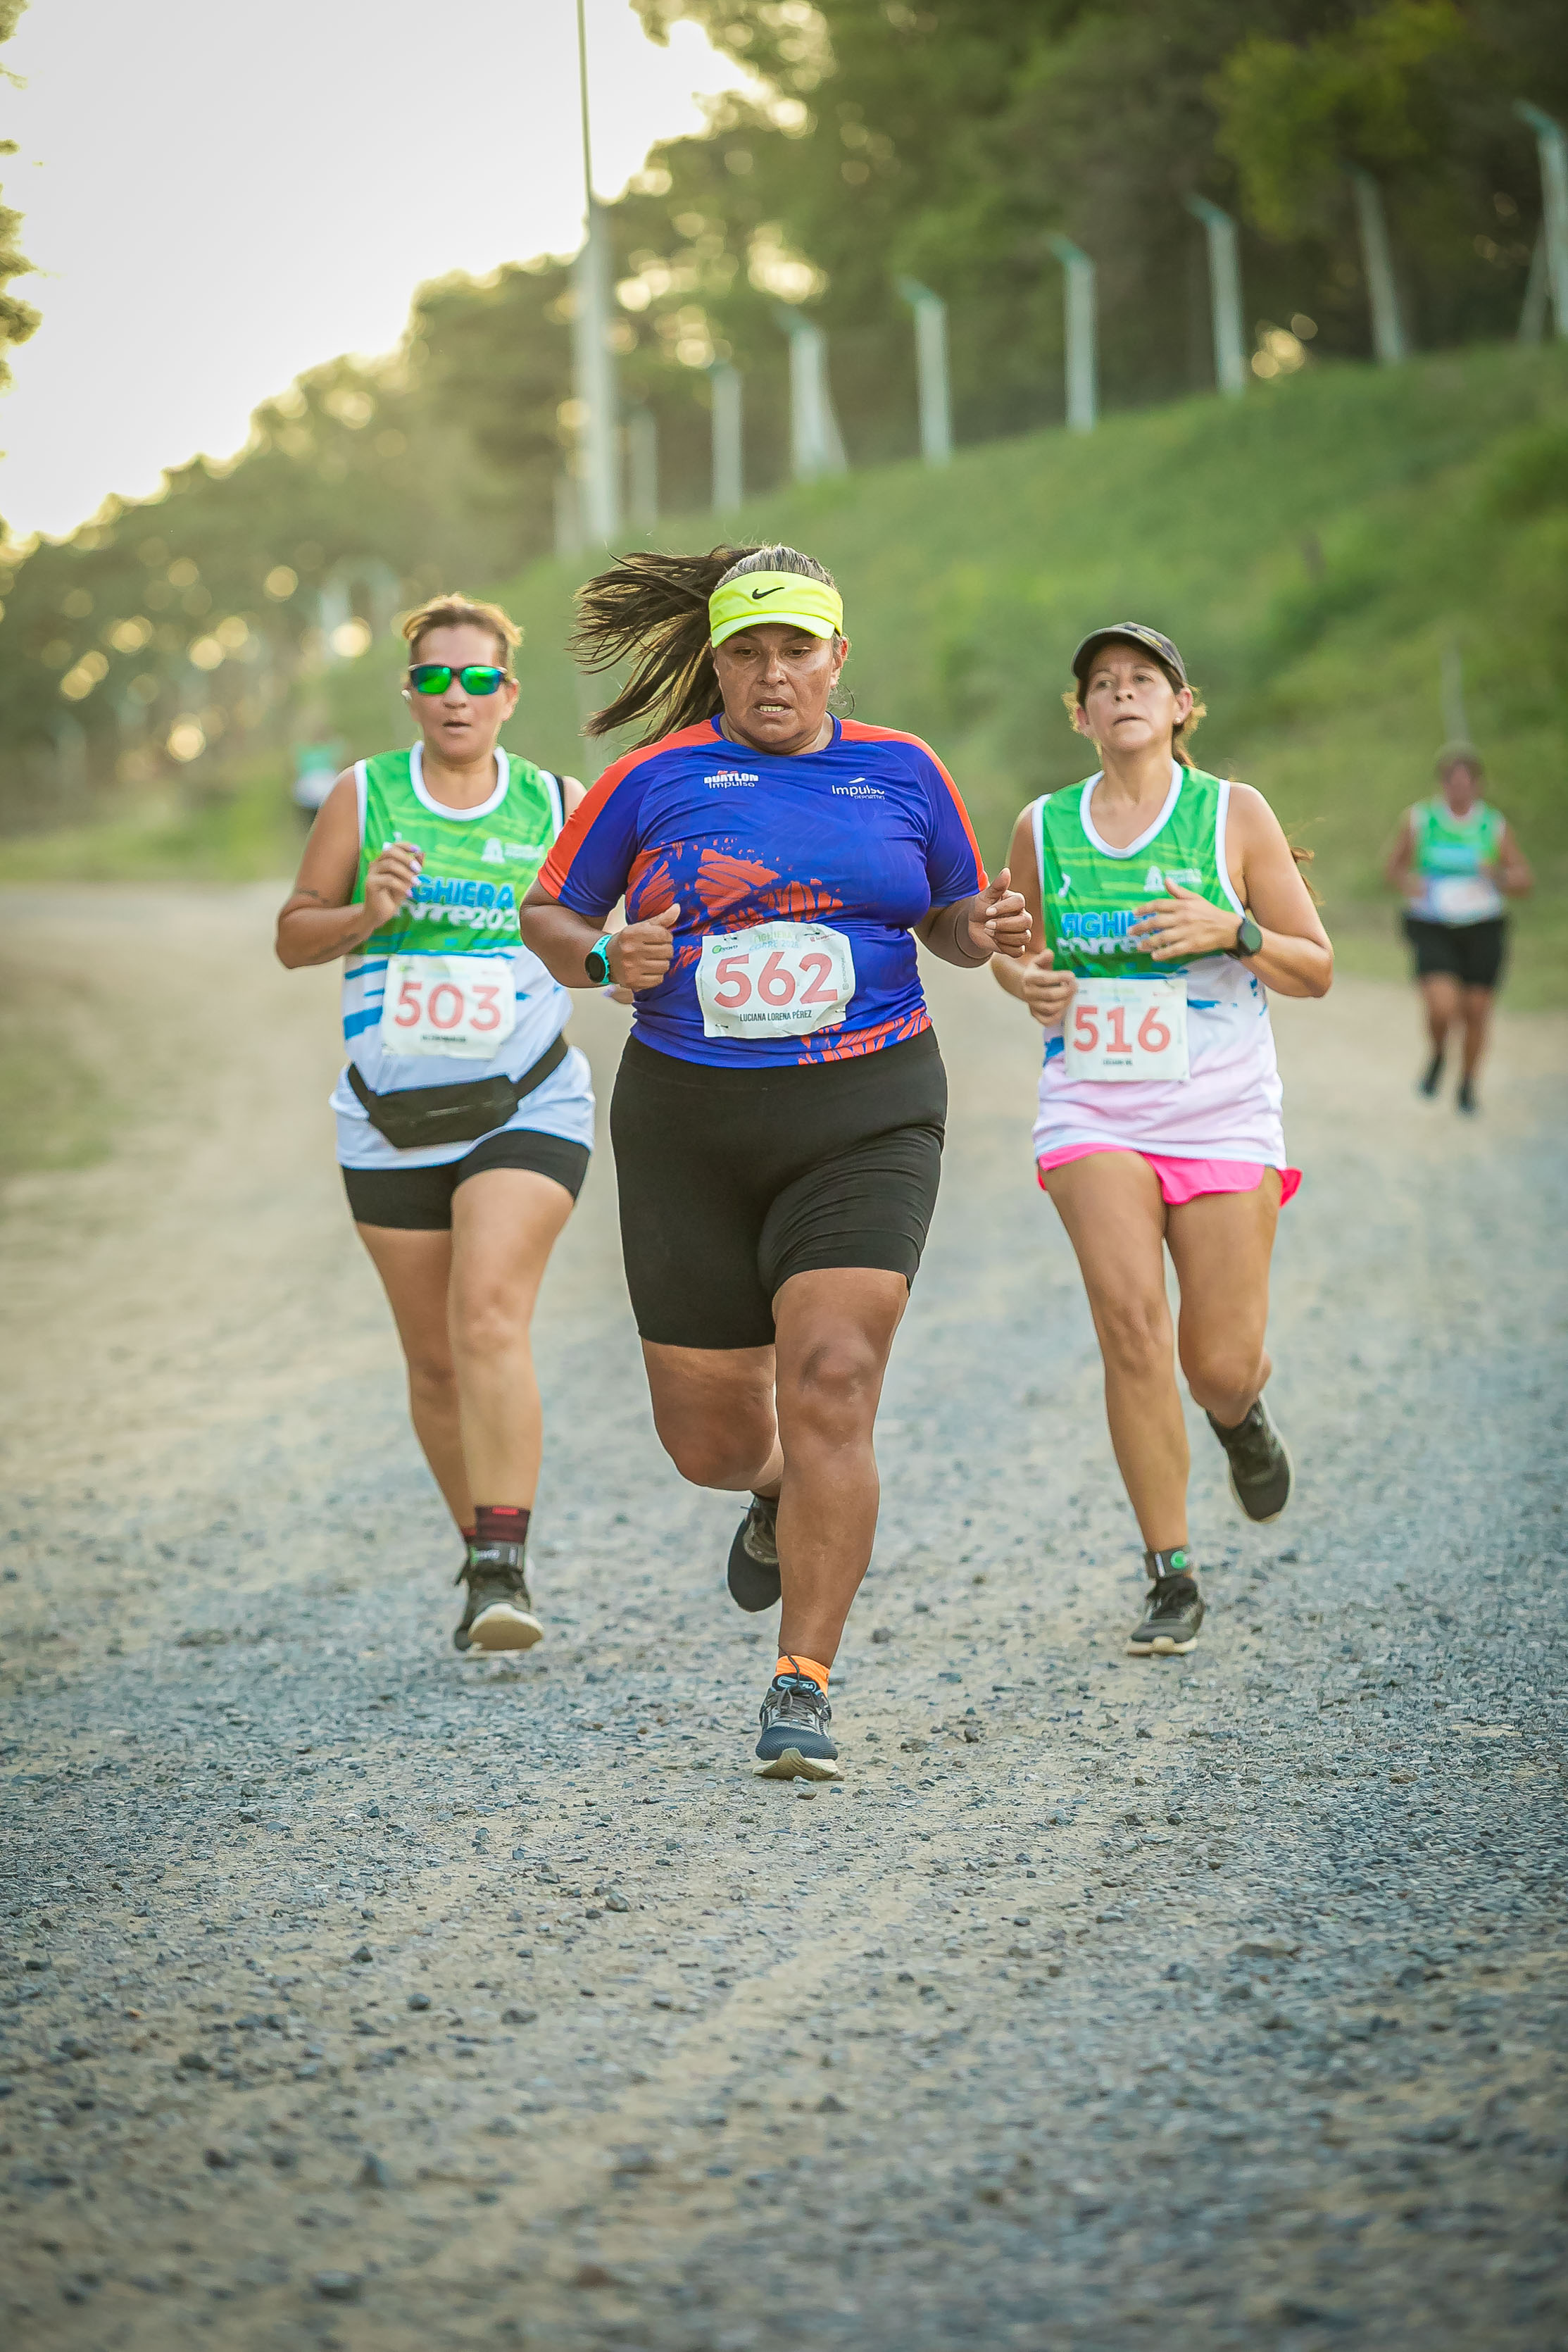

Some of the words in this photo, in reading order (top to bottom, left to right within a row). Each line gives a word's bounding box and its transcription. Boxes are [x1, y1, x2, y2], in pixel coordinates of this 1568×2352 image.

[408, 873, 515, 910] GHIERA
[714, 951, 838, 1008] 562
[394, 980, 501, 1031] 503
[740, 1013, 766, 1022] LUCIANA
[767, 1012, 791, 1021] LORENA
[792, 1009, 812, 1020] PÉREZ
[1072, 1006, 1172, 1053] 516
